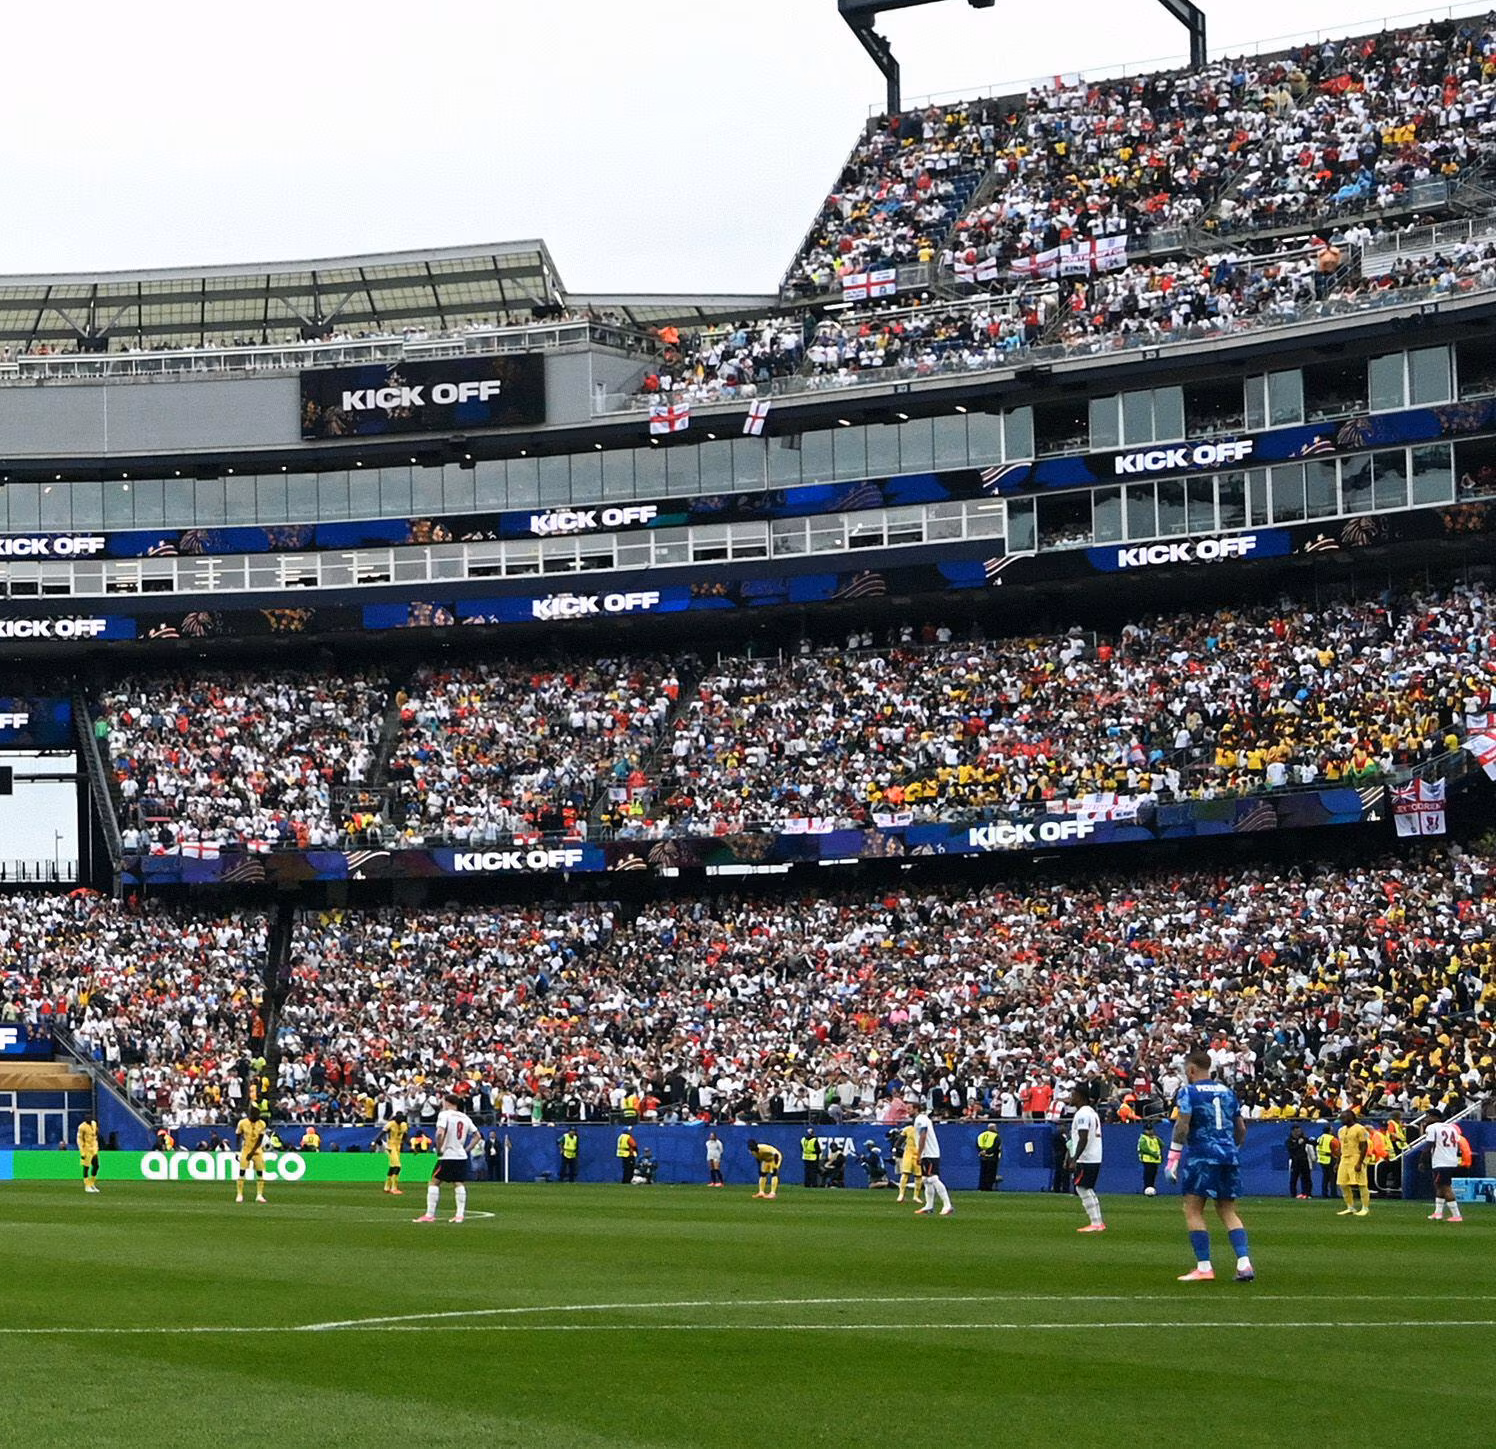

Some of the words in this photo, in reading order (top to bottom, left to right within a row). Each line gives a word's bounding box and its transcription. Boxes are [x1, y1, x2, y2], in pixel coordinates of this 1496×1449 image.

[343, 387, 424, 410] KICK
[433, 381, 500, 403] OFF
[1116, 449, 1187, 473] KICK
[1194, 441, 1252, 464] OFF
[531, 511, 596, 535] KICK
[602, 506, 656, 525] OFF
[54, 538, 104, 554] OFF
[1119, 543, 1191, 566] KICK
[1197, 536, 1256, 558] OFF
[533, 597, 599, 620] KICK
[605, 592, 659, 611] OFF
[55, 620, 105, 636] OFF
[970, 823, 1034, 848] KICK
[1040, 820, 1094, 840] OFF
[455, 852, 519, 870] KICK
[523, 850, 582, 868] OFF
[1212, 1096, 1223, 1130] 1
[457, 1121, 464, 1140] 8
[1441, 1130, 1457, 1148] 24
